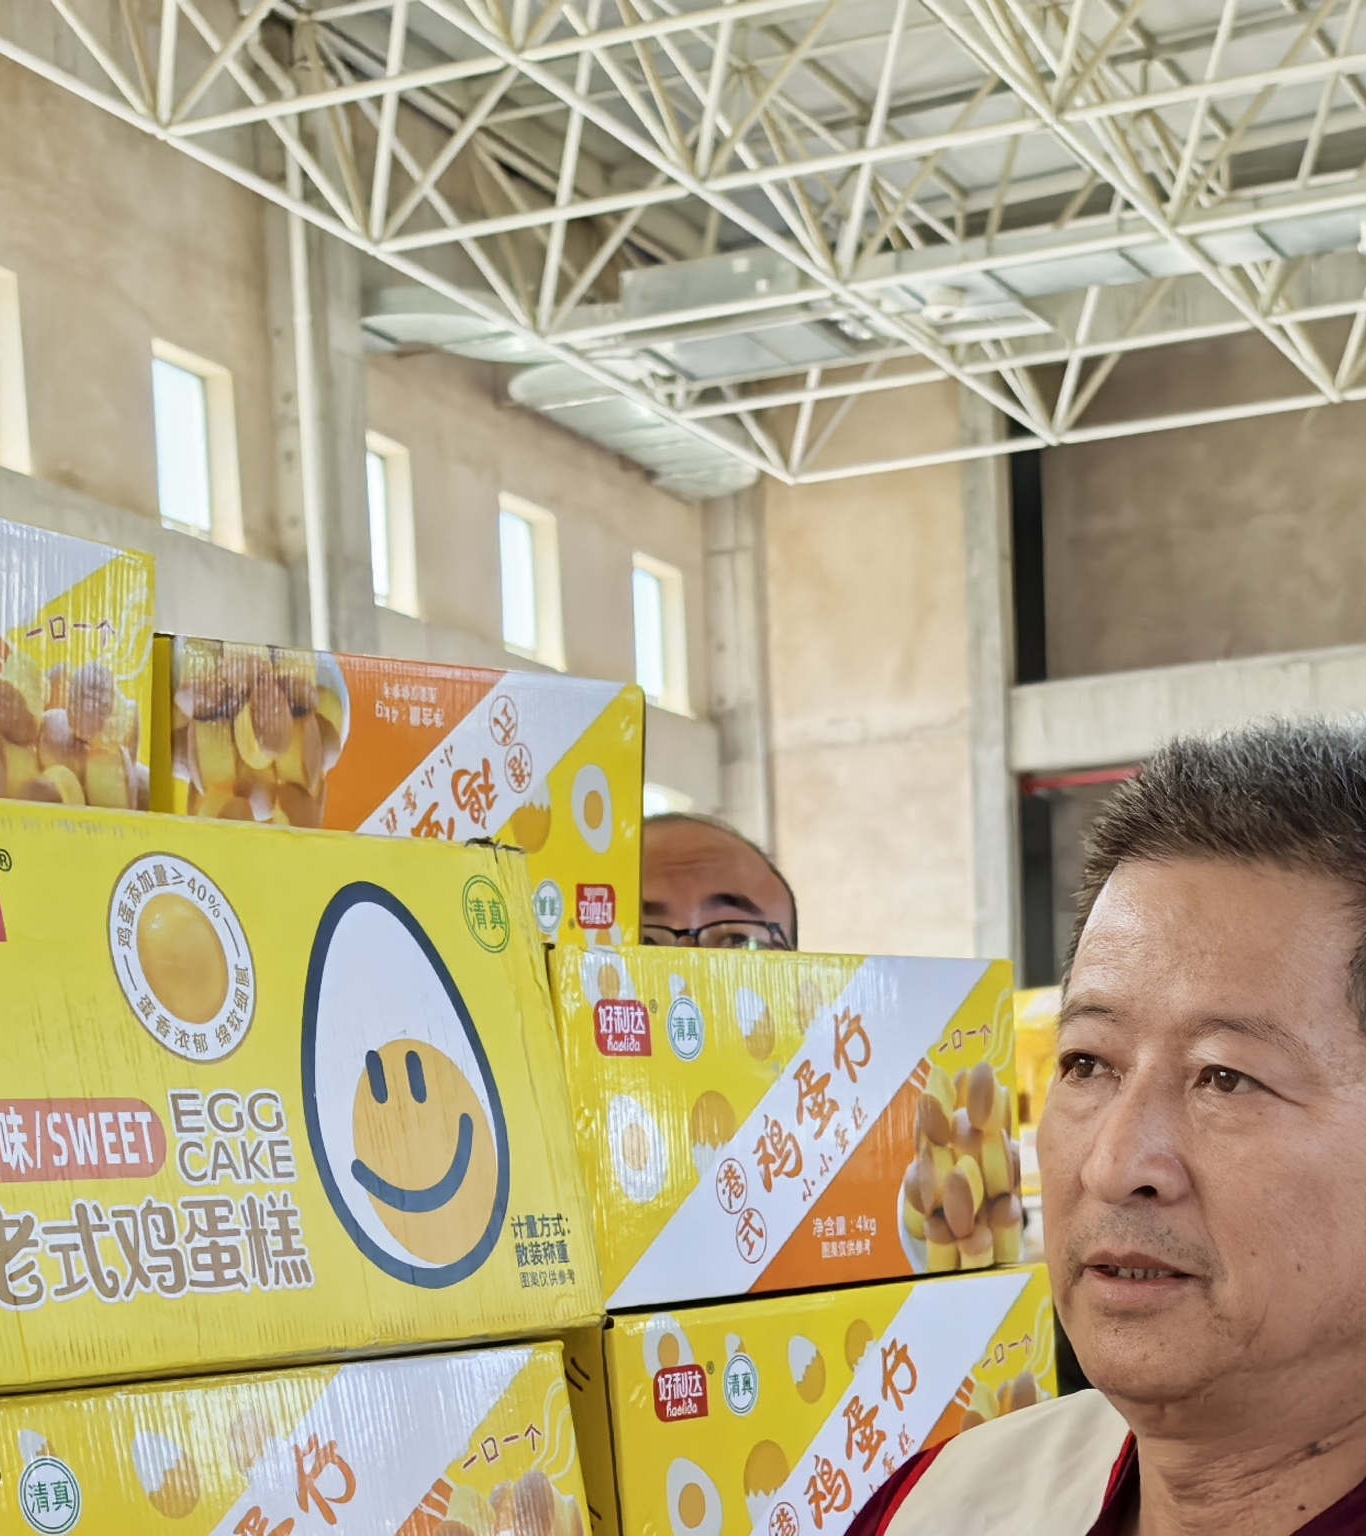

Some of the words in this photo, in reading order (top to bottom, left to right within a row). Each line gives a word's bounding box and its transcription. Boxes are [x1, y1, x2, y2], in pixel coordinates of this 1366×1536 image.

[467, 896, 509, 932] 清真
[136, 993, 209, 1054] 蛋香浓郁
[597, 1004, 647, 1038] 好利达
[671, 1015, 700, 1044] 清真
[169, 1089, 285, 1135] EGG
[752, 1006, 874, 1194] 鸡蛋仔
[177, 1138, 297, 1185] CAKE
[717, 1160, 767, 1263] 港式
[513, 1241, 571, 1269] 散装称重
[657, 1369, 704, 1402] 好利达
[726, 1369, 755, 1399] 清真
[801, 1337, 919, 1530] 鸡蛋仔
[26, 1477, 74, 1514] 清真
